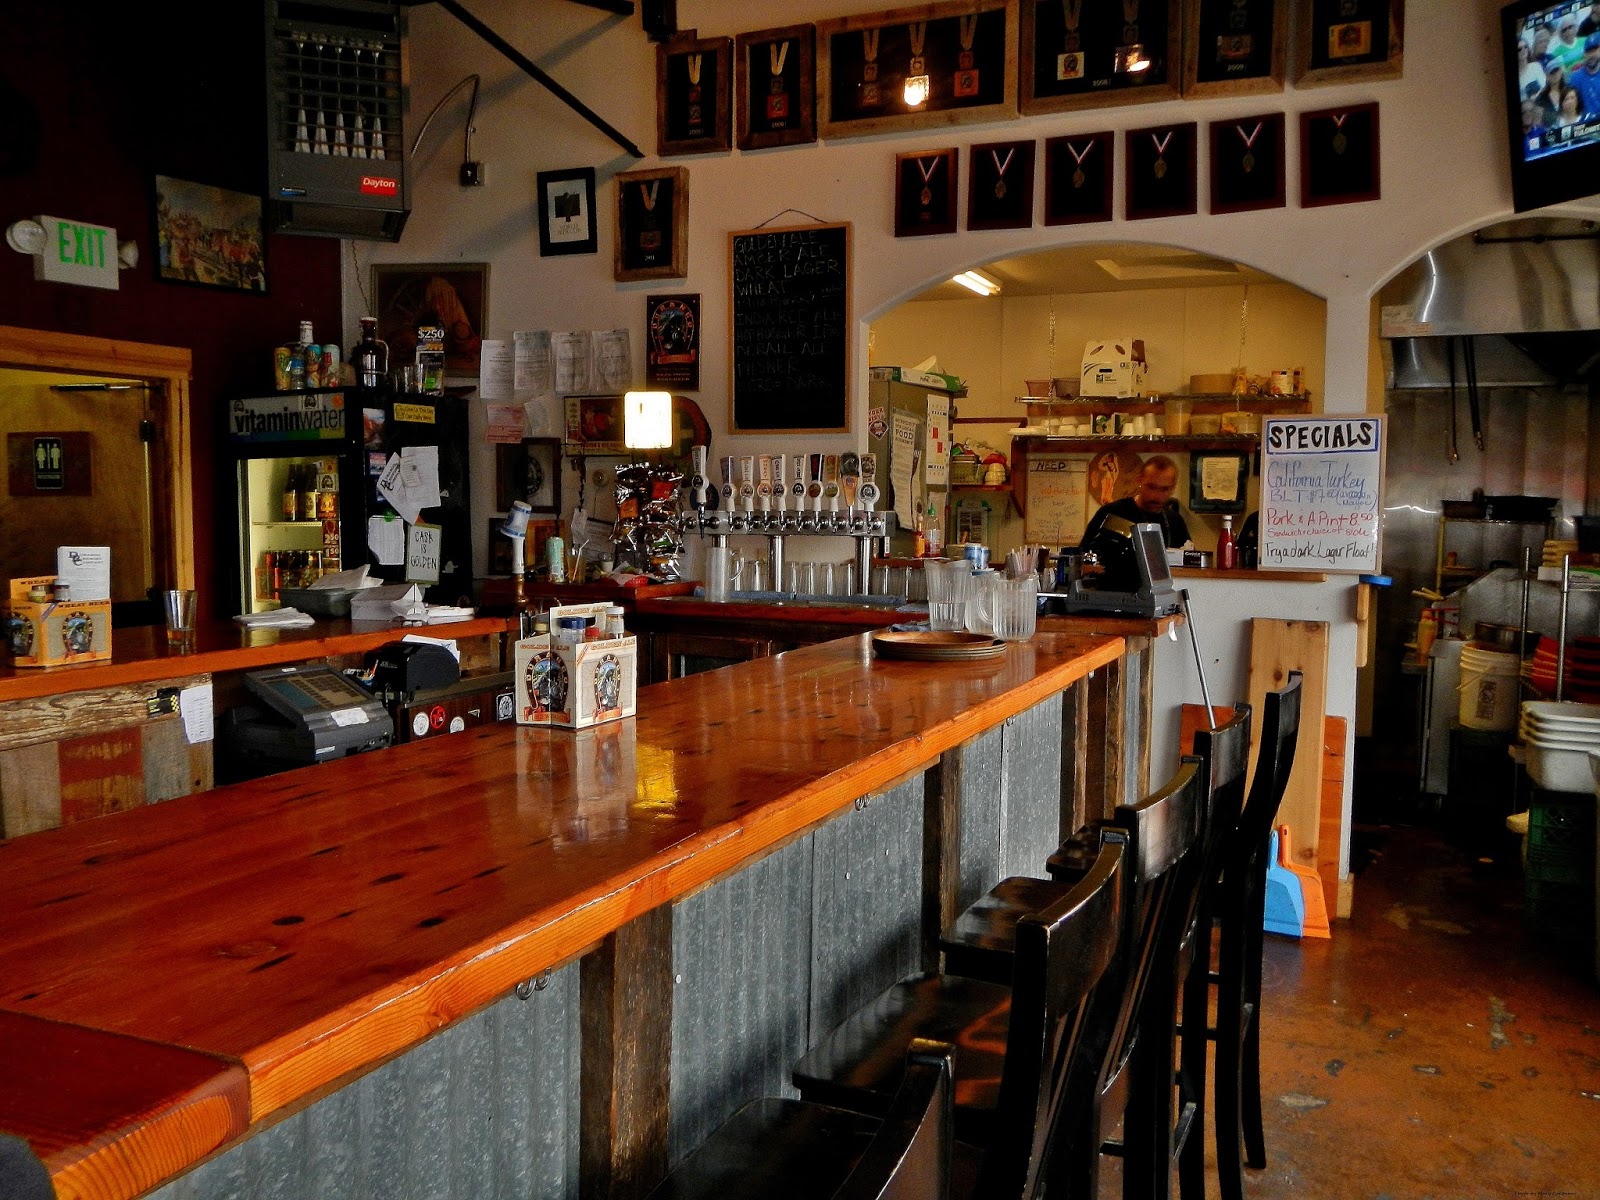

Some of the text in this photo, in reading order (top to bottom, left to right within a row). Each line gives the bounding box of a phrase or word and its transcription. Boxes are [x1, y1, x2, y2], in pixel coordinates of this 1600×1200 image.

[362, 177, 395, 188] Dayton
[58, 221, 107, 268] EXIT
[789, 231, 820, 248] ALE
[735, 244, 832, 266] AMBER ALE
[736, 259, 839, 281] DARK LAGER
[736, 280, 787, 296] WHEAT
[418, 329, 445, 339] $250
[234, 406, 345, 433] vitaminwater
[1269, 422, 1373, 450] SPECIALS
[1268, 461, 1325, 488] California
[1321, 461, 1366, 492] Turkey
[1267, 508, 1296, 526] Pork
[1307, 511, 1316, 526] A
[414, 531, 434, 544] CASK
[420, 544, 427, 553] IS
[1265, 542, 1283, 564] Try
[1290, 540, 1317, 559] dark
[1316, 542, 1346, 565] Lager
[410, 556, 437, 569] GOLDEN
